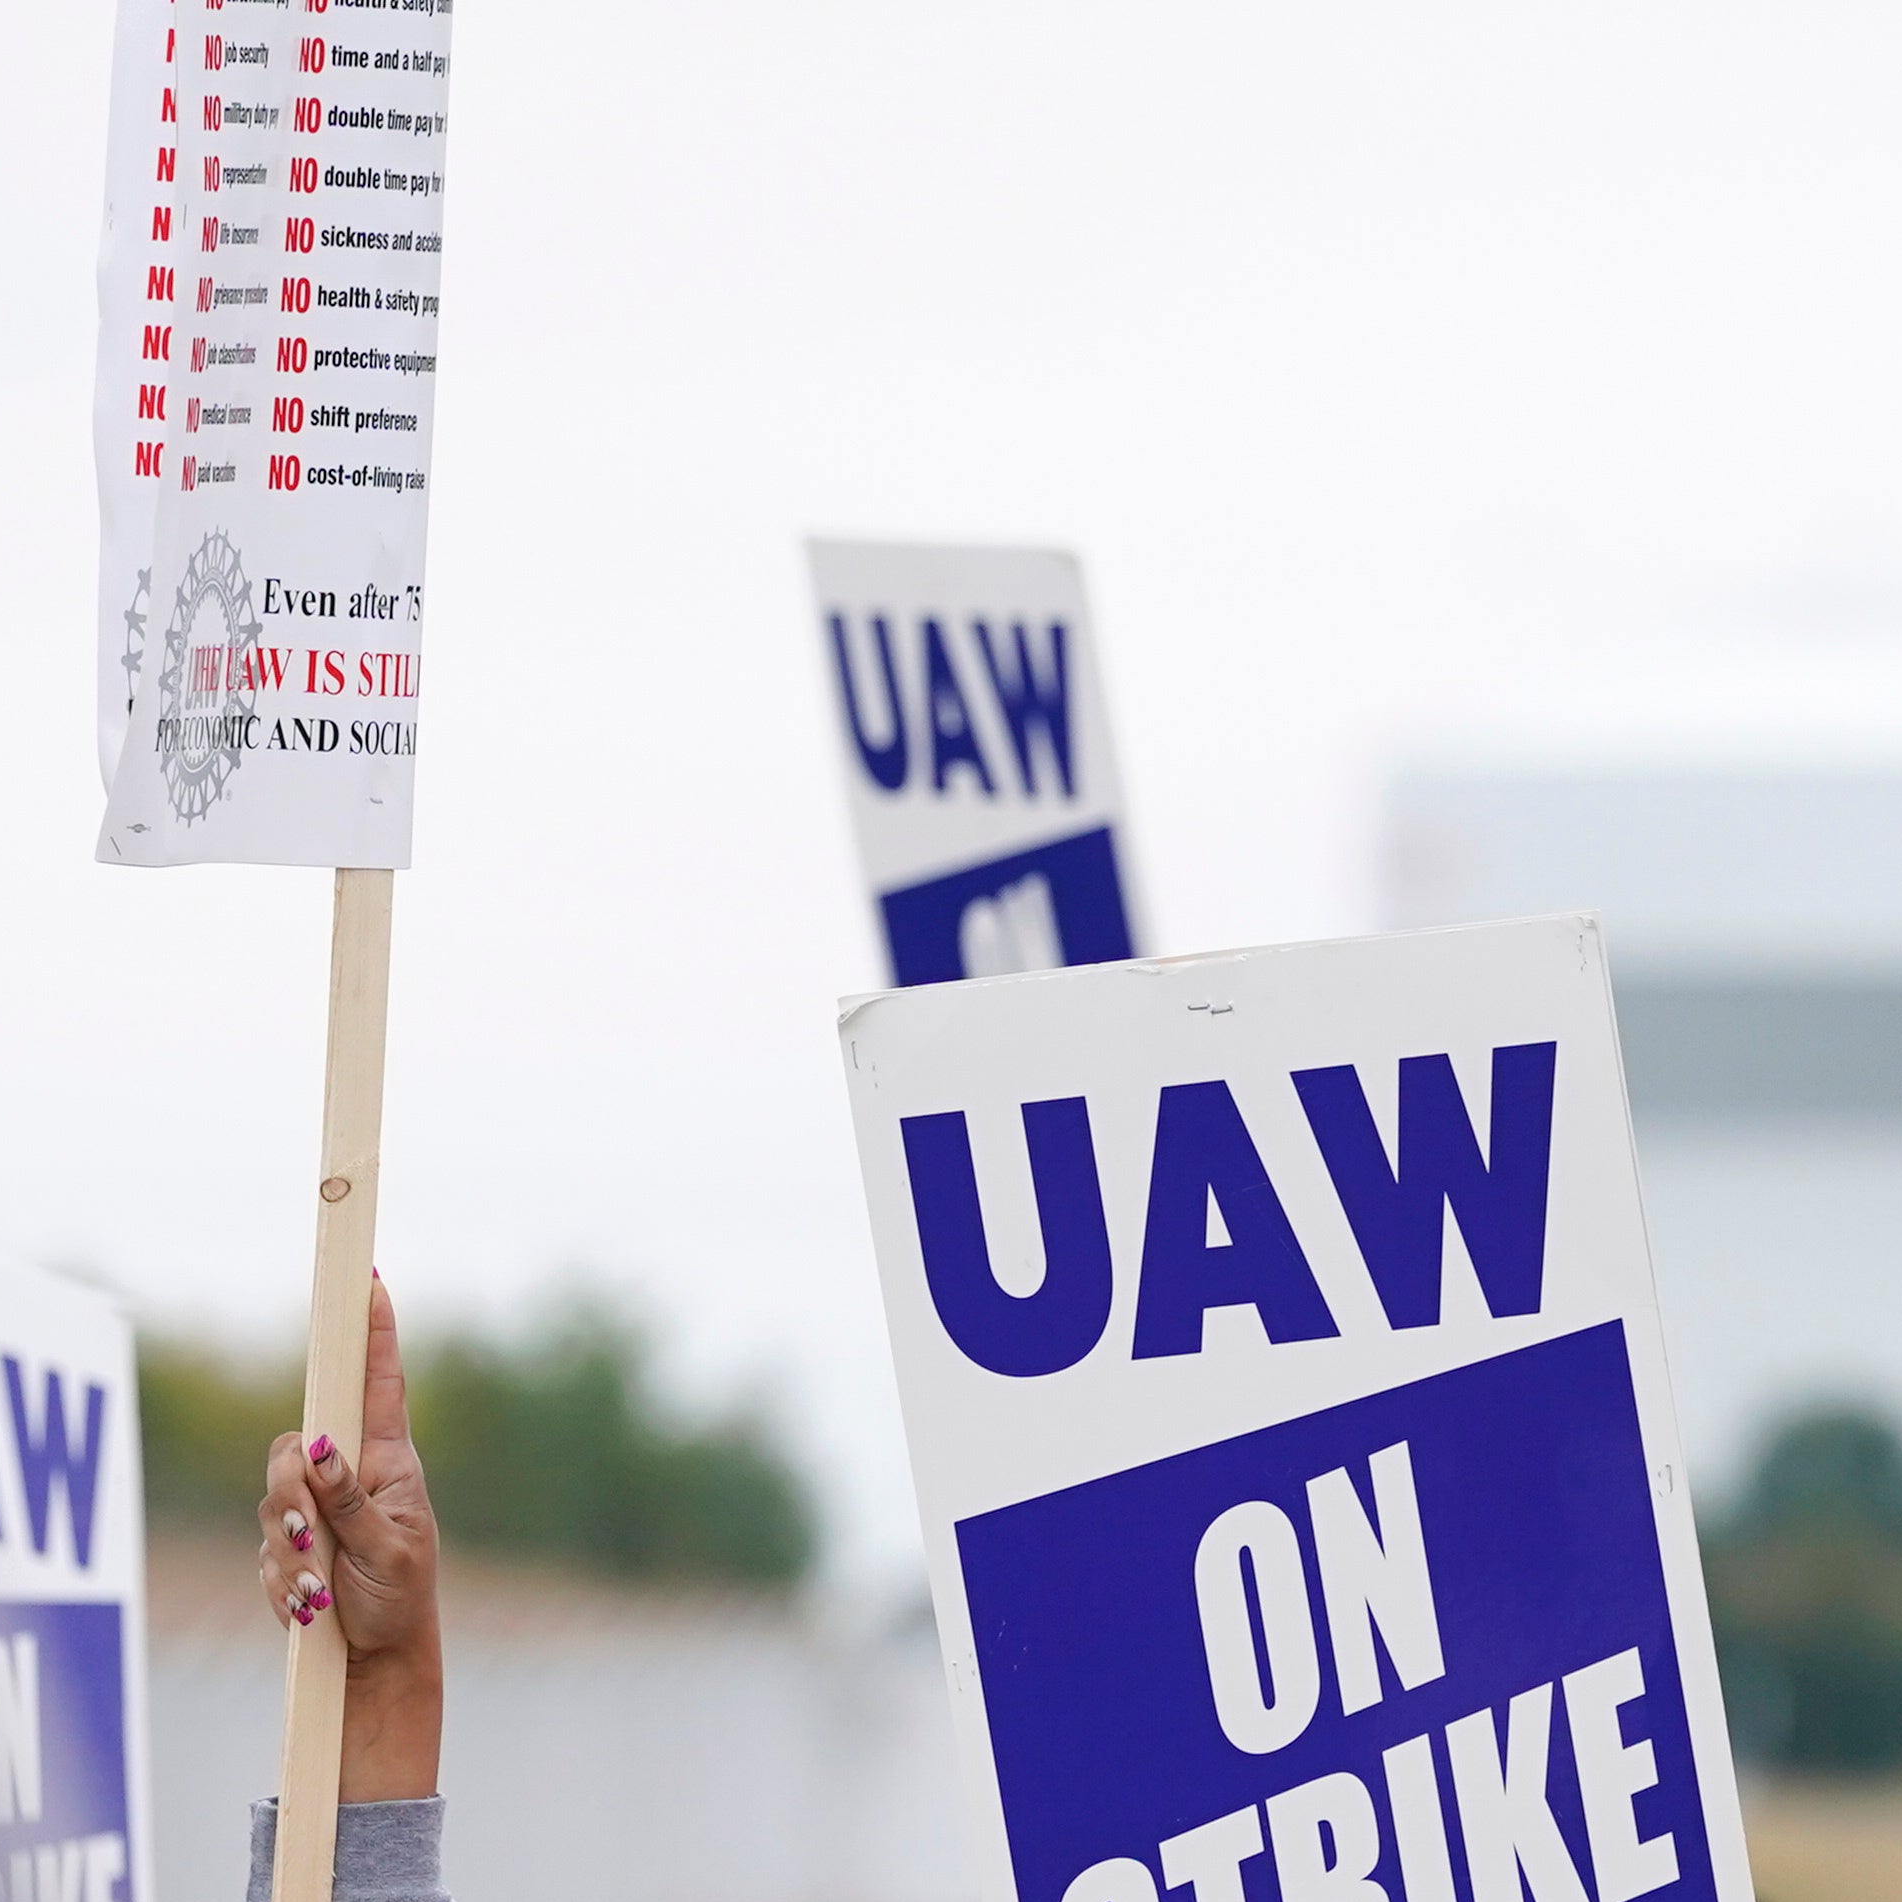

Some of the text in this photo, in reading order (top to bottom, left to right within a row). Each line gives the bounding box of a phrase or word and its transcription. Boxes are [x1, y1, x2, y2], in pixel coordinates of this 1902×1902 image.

[205, 35, 222, 70] NO
[225, 41, 237, 68] job
[239, 42, 269, 68] security
[299, 37, 446, 78] NO time and a half pay
[204, 95, 221, 131] NO
[294, 97, 322, 134] NO
[328, 105, 384, 130] double
[387, 109, 412, 131] time
[414, 115, 433, 137] pay
[204, 156, 220, 192] NO
[289, 157, 318, 194] NO
[324, 165, 380, 189] double
[384, 169, 407, 191] time
[410, 175, 430, 197] pay
[202, 216, 218, 252] NO
[285, 217, 315, 254] NO
[321, 226, 389, 250] sickness
[392, 230, 413, 251] and
[196, 276, 213, 313] NO
[281, 277, 311, 313] NO
[317, 285, 370, 309] health
[375, 288, 382, 309] &
[385, 290, 419, 317] safety
[190, 337, 206, 373] NO
[277, 337, 307, 374] NO
[314, 347, 391, 371] protective
[186, 398, 200, 433] NO
[272, 397, 417, 434] NO shift preference
[181, 456, 197, 491] NO
[268, 454, 426, 493] NO cost-of-living raise
[263, 578, 421, 621] Even after 75
[226, 647, 293, 692] UAW
[304, 650, 345, 695] IS
[827, 610, 1077, 799] UAW
[182, 715, 261, 750] ECONOMIC
[266, 717, 339, 752] AND
[899, 1040, 1559, 1378] UAW
[1192, 1440, 1446, 1756] ON
